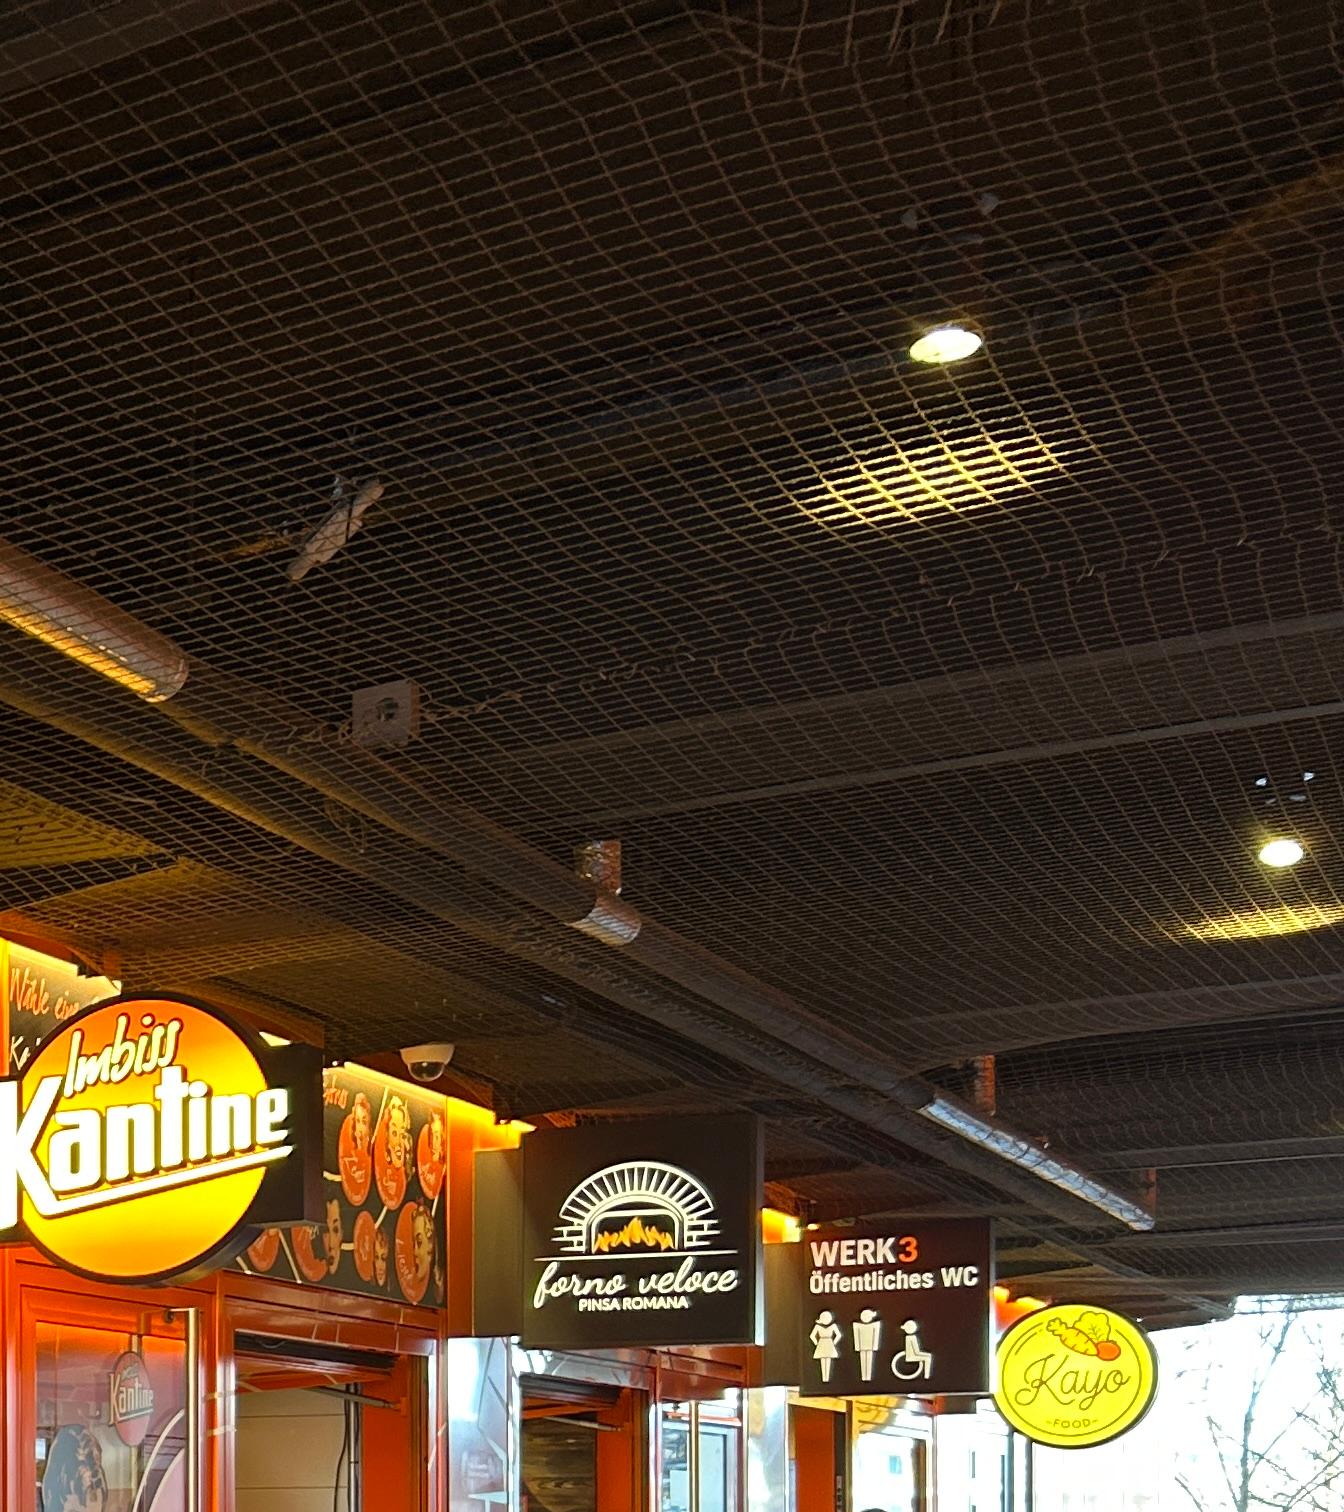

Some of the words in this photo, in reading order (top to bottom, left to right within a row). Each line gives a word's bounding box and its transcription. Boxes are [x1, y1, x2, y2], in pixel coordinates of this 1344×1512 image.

[533, 1258, 627, 1309] forno
[636, 1257, 738, 1295] veloce
[808, 1268, 934, 1295] Öffentliches
[940, 1265, 980, 1288] WC
[578, 1296, 620, 1313] PINSA
[622, 1294, 689, 1311] ROMANA
[1016, 1352, 1132, 1411] Kayo
[1052, 1416, 1091, 1430] FOOD
